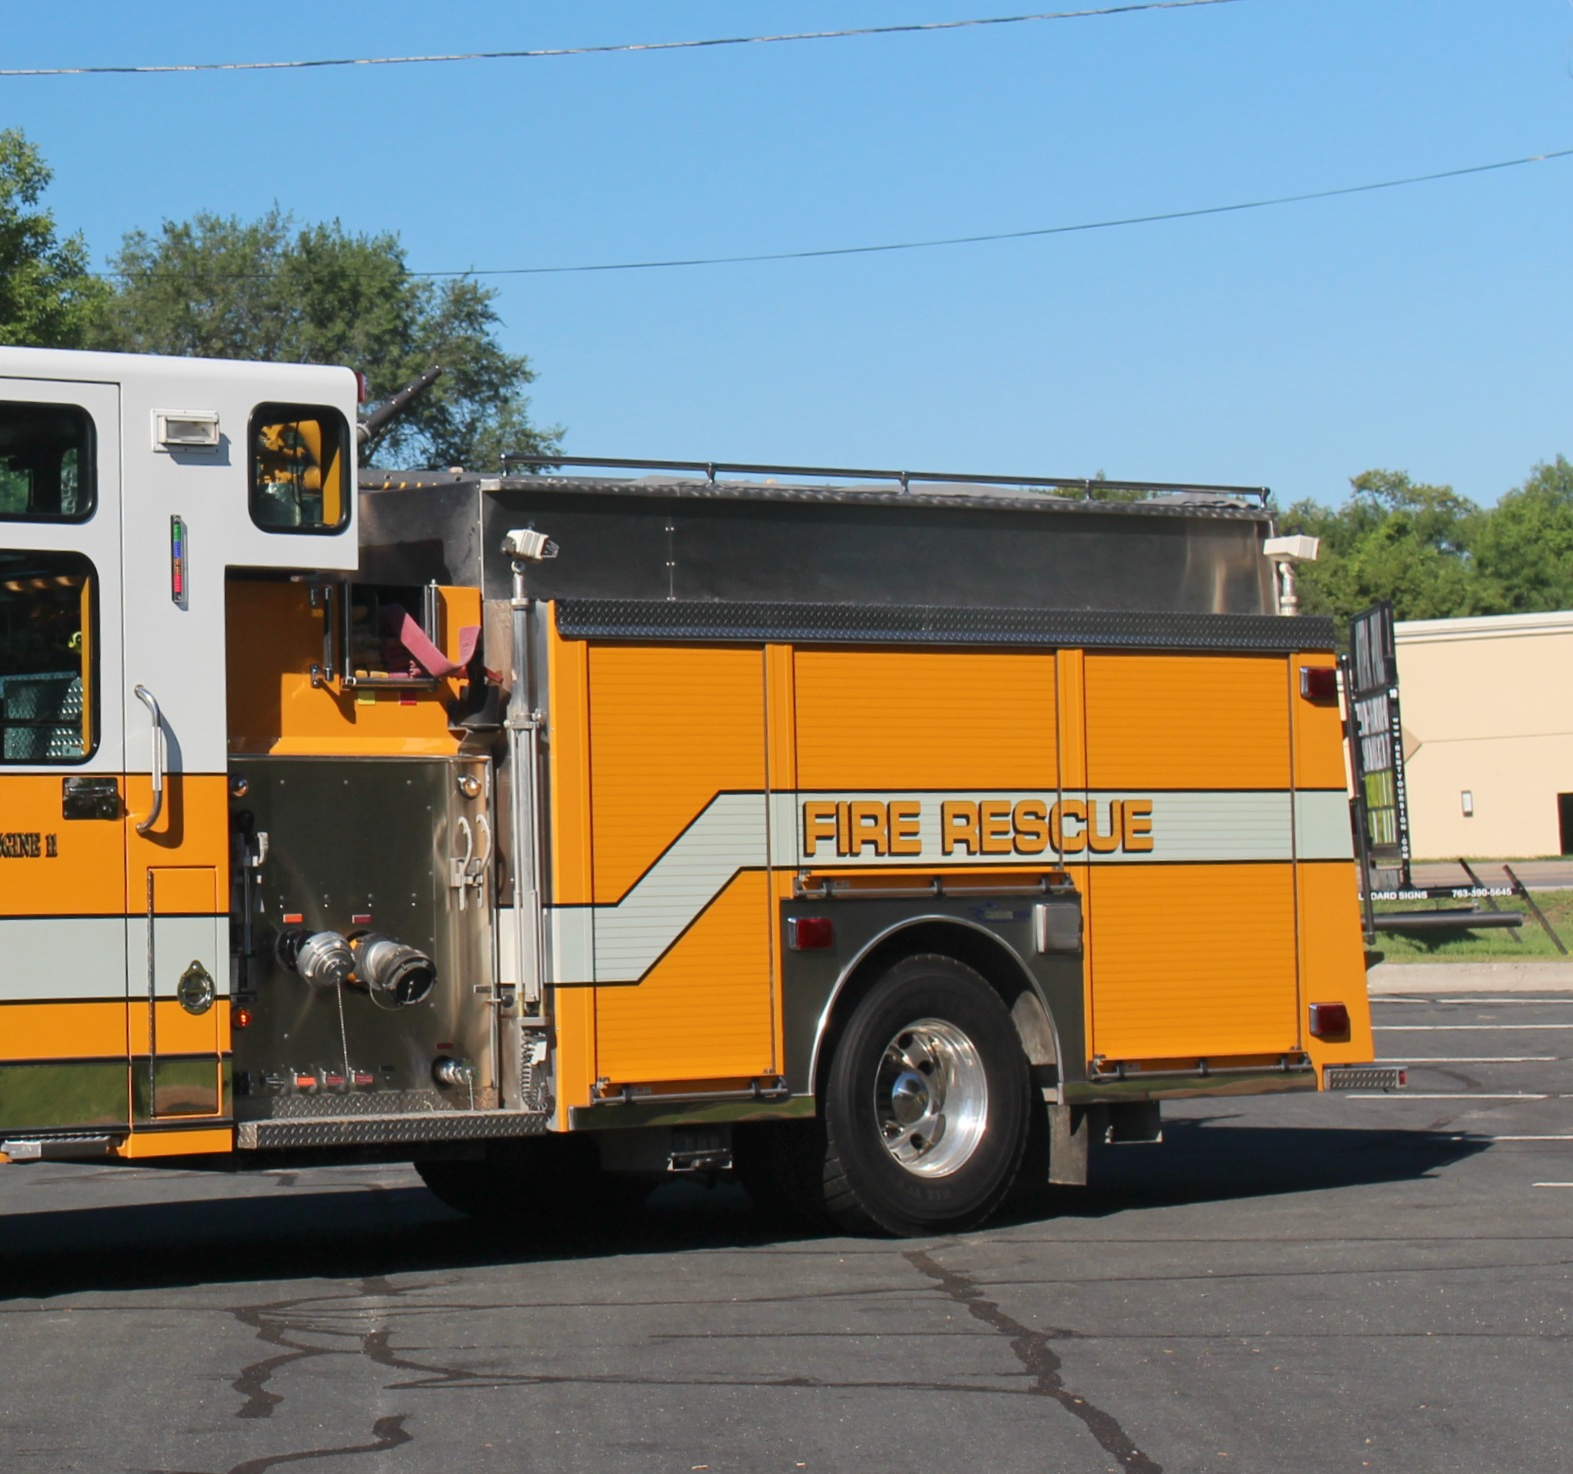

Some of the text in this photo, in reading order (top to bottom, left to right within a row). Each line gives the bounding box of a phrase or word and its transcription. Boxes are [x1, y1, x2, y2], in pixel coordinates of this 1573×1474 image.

[803, 799, 1154, 858] FIRE RESCUE
[44, 832, 59, 858] 11
[1398, 890, 1428, 900] SIGNS
